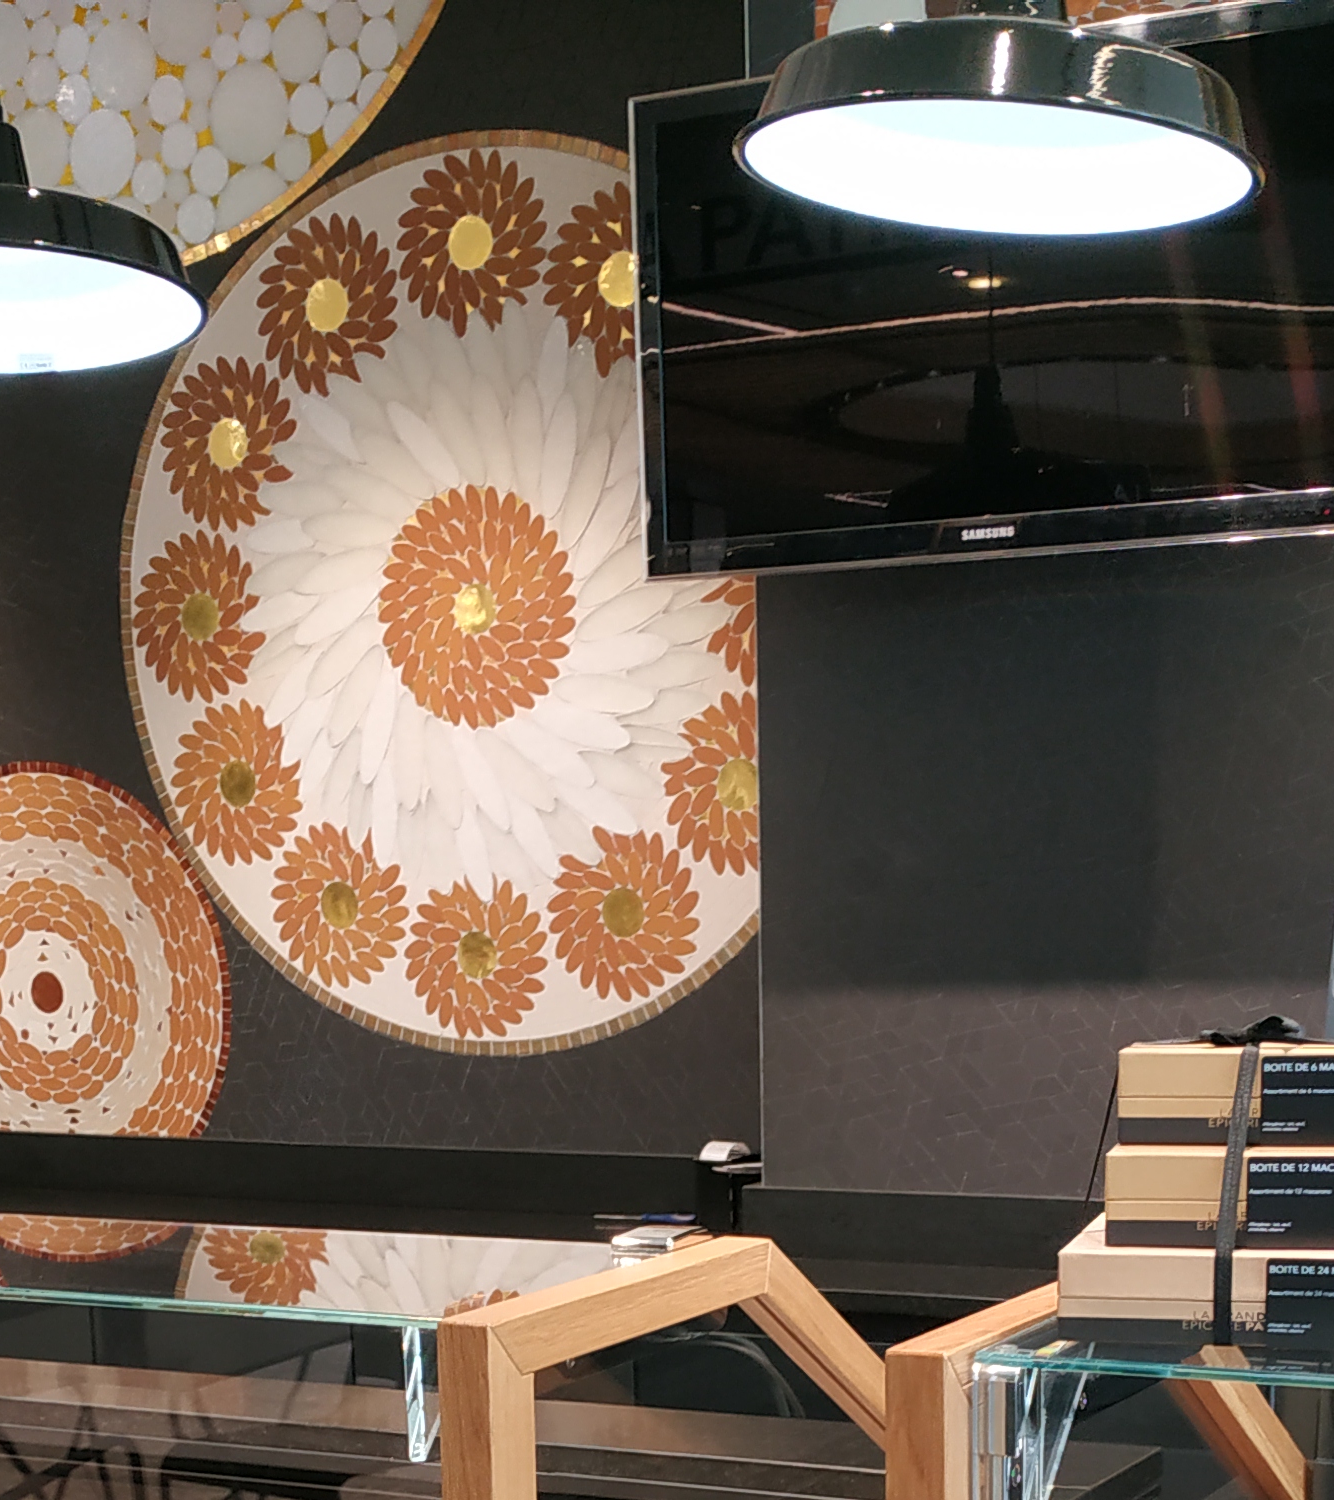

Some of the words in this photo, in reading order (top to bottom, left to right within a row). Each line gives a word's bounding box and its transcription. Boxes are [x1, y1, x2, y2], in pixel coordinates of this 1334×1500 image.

[960, 525, 1015, 541] SAMSUNG
[1263, 1061, 1293, 1072] BOITE
[1294, 1062, 1309, 1072] DE
[1311, 1062, 1317, 1072] 6
[1249, 1163, 1279, 1173] BOITE
[1281, 1163, 1296, 1173] DE
[1298, 1163, 1309, 1173] 12
[1268, 1265, 1299, 1275] BOITE
[1301, 1266, 1315, 1275] DE
[1317, 1266, 1330, 1275] 24
